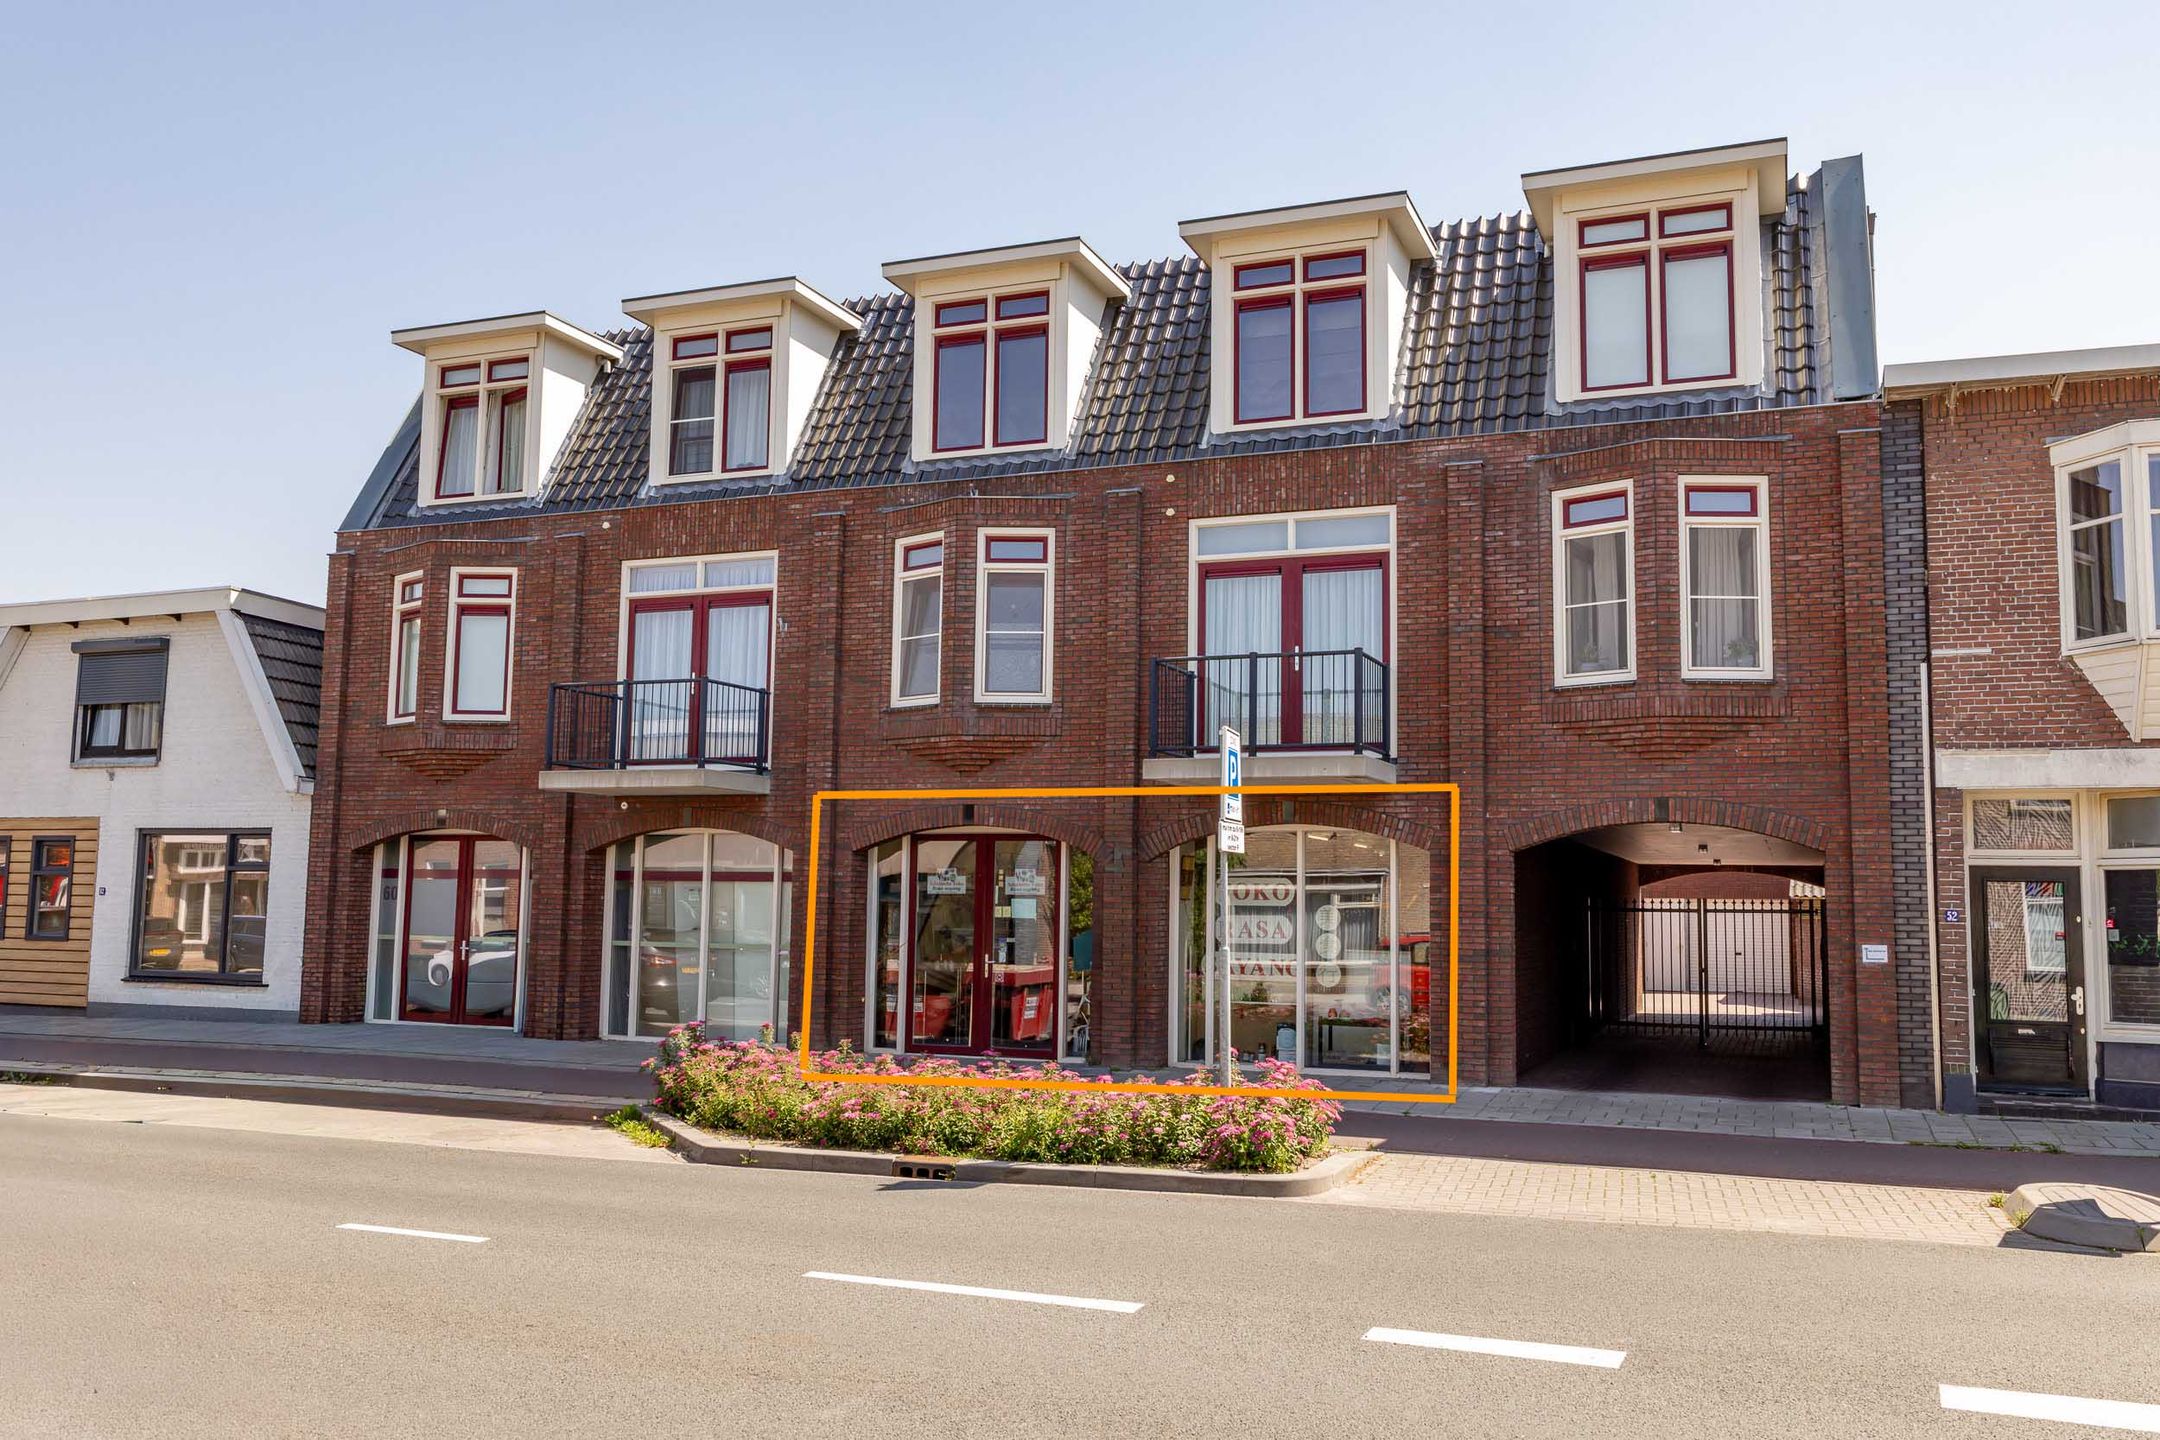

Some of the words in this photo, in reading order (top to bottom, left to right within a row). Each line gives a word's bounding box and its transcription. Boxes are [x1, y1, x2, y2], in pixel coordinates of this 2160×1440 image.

[1229, 754, 1238, 788] P
[383, 885, 398, 900] 60
[1228, 883, 1290, 901] OKO
[1946, 911, 1958, 921] 52
[1228, 957, 1297, 977] YAN
